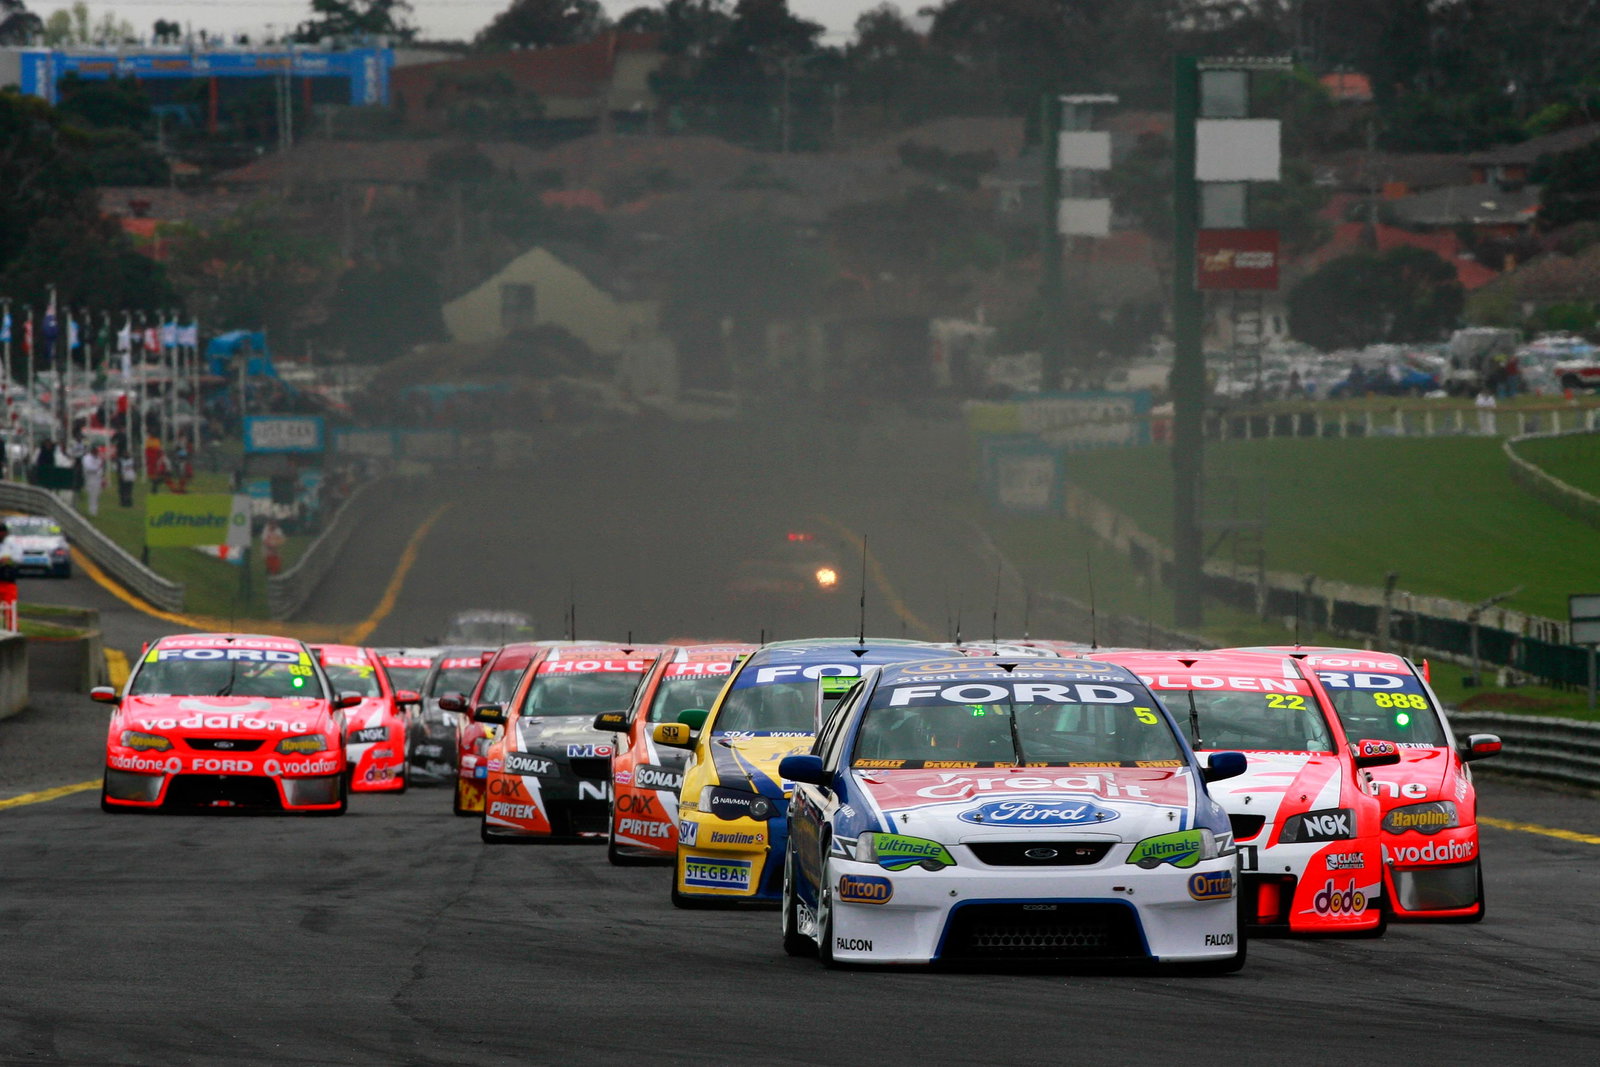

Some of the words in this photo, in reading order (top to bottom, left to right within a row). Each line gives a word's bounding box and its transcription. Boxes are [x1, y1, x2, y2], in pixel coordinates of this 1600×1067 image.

[150, 511, 228, 527] ultimate
[158, 649, 299, 662] FORD
[1306, 656, 1398, 670] fone
[287, 664, 313, 676] 88
[896, 673, 958, 684] Steel
[987, 671, 1045, 679] Tube
[1075, 672, 1125, 682] Pipe
[889, 683, 1135, 706] FORD
[1265, 693, 1307, 711] 22
[1373, 691, 1428, 710] 888
[140, 714, 308, 733] vodafone
[1133, 706, 1159, 725] 5
[358, 729, 384, 743] NGK
[662, 726, 680, 738] SP
[1364, 742, 1395, 756] dodo
[192, 758, 254, 772] FORD
[507, 755, 551, 773] SONAX
[719, 797, 751, 807] NAVMAN
[490, 801, 536, 820] PIRTEK
[991, 801, 1086, 821] Ford
[1304, 814, 1350, 837] NGK
[1391, 811, 1449, 827] Havoline
[618, 818, 672, 839] PIRTEK
[711, 832, 754, 844] Havoline
[877, 840, 942, 856] ultimate
[1142, 839, 1200, 857] ultimate
[687, 864, 747, 881] STEGBAR
[841, 878, 887, 897] Orrcon
[1314, 879, 1366, 916] dodo
[837, 938, 872, 951] FALCON
